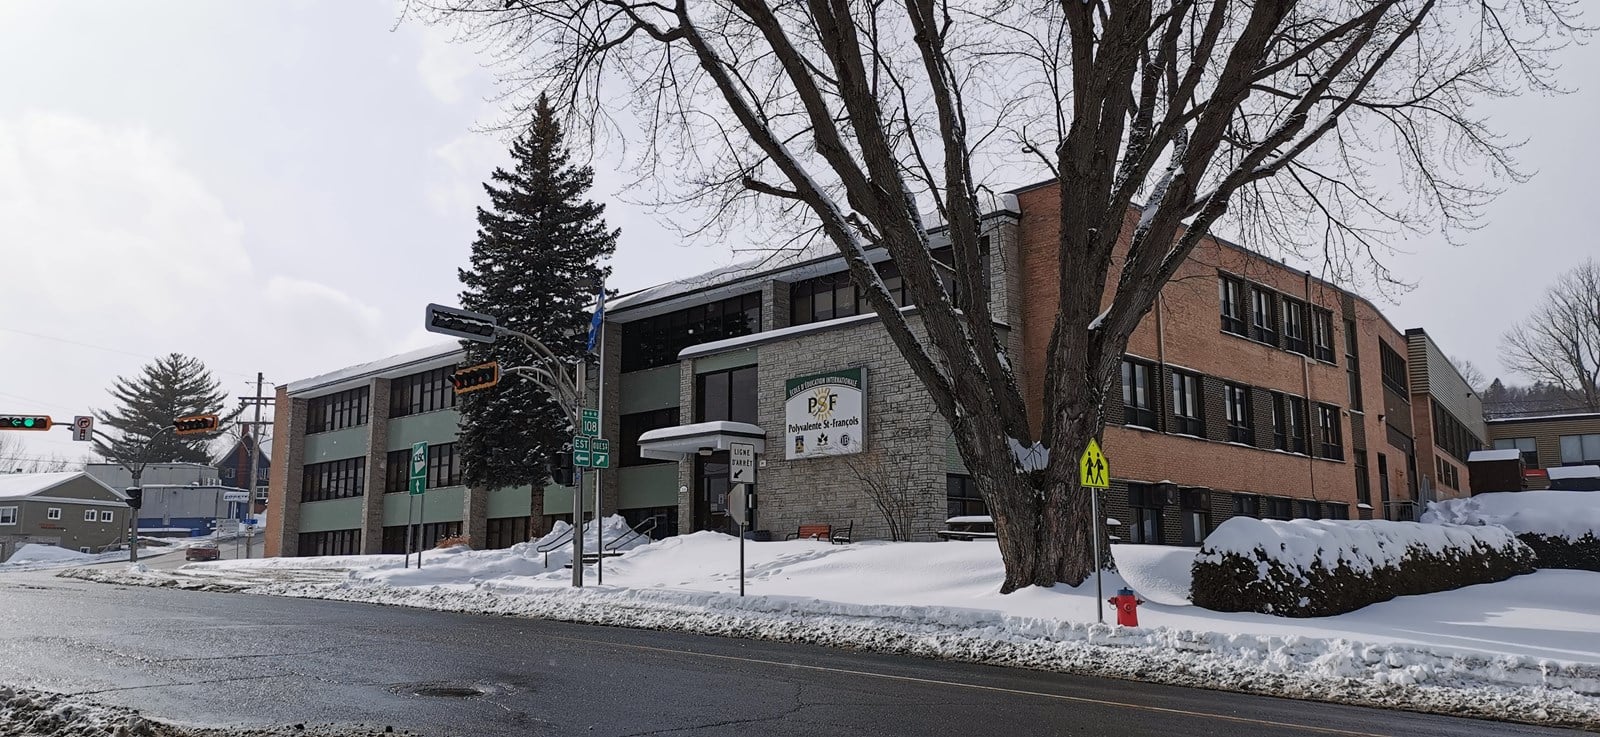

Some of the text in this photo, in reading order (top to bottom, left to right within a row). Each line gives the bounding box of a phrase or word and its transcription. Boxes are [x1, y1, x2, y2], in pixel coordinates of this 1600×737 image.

[826, 376, 858, 386] INTERNATIONALE
[808, 394, 838, 413] PSF
[584, 420, 597, 432] 108
[788, 416, 859, 434] Polyvalente St-François
[575, 439, 588, 449] EST
[593, 442, 607, 450] OUEST
[734, 448, 750, 457] LIGNE
[732, 458, 752, 467] D'ARRÊT
